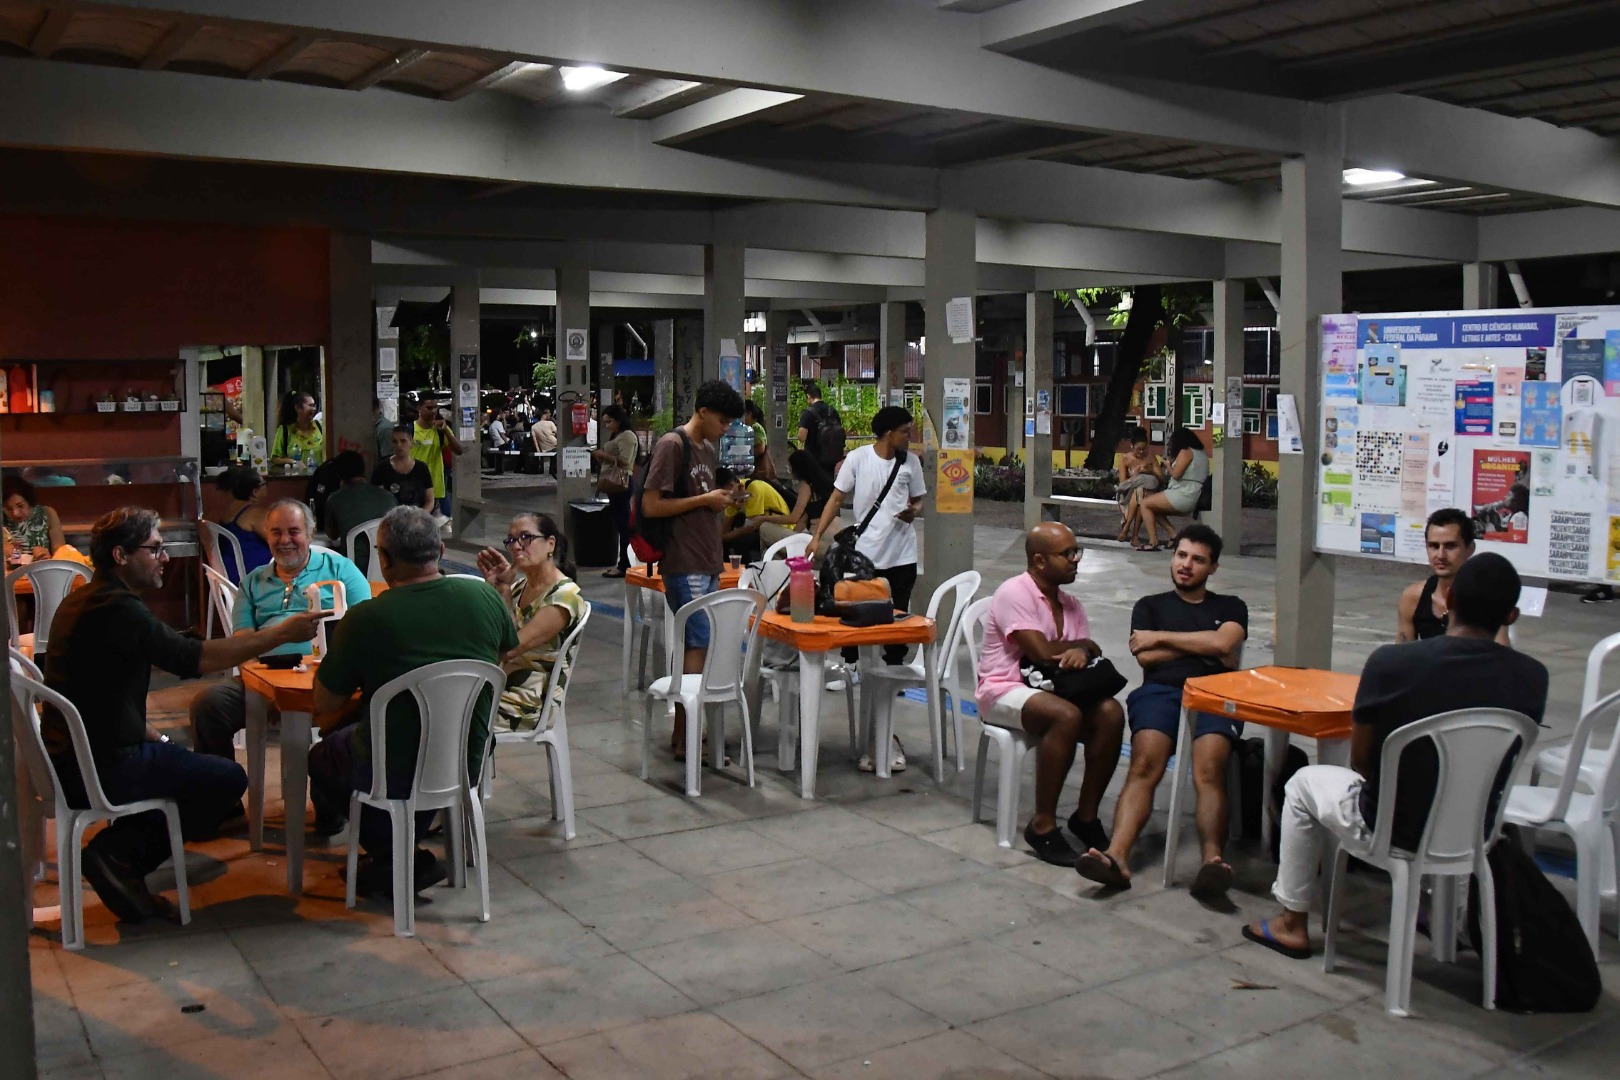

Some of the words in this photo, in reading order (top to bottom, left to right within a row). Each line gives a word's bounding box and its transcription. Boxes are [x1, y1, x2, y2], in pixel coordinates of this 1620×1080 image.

[1383, 325, 1422, 334] UNIVERSIDADE
[1462, 323, 1481, 332] CENTRO
[1481, 323, 1489, 331] DE
[1383, 333, 1406, 342] FEDERAL
[1406, 333, 1415, 342] DA
[1462, 334, 1481, 343] LETRAS
[1485, 333, 1501, 342] ARTES
[1481, 462, 1521, 471] ORGANIZE
